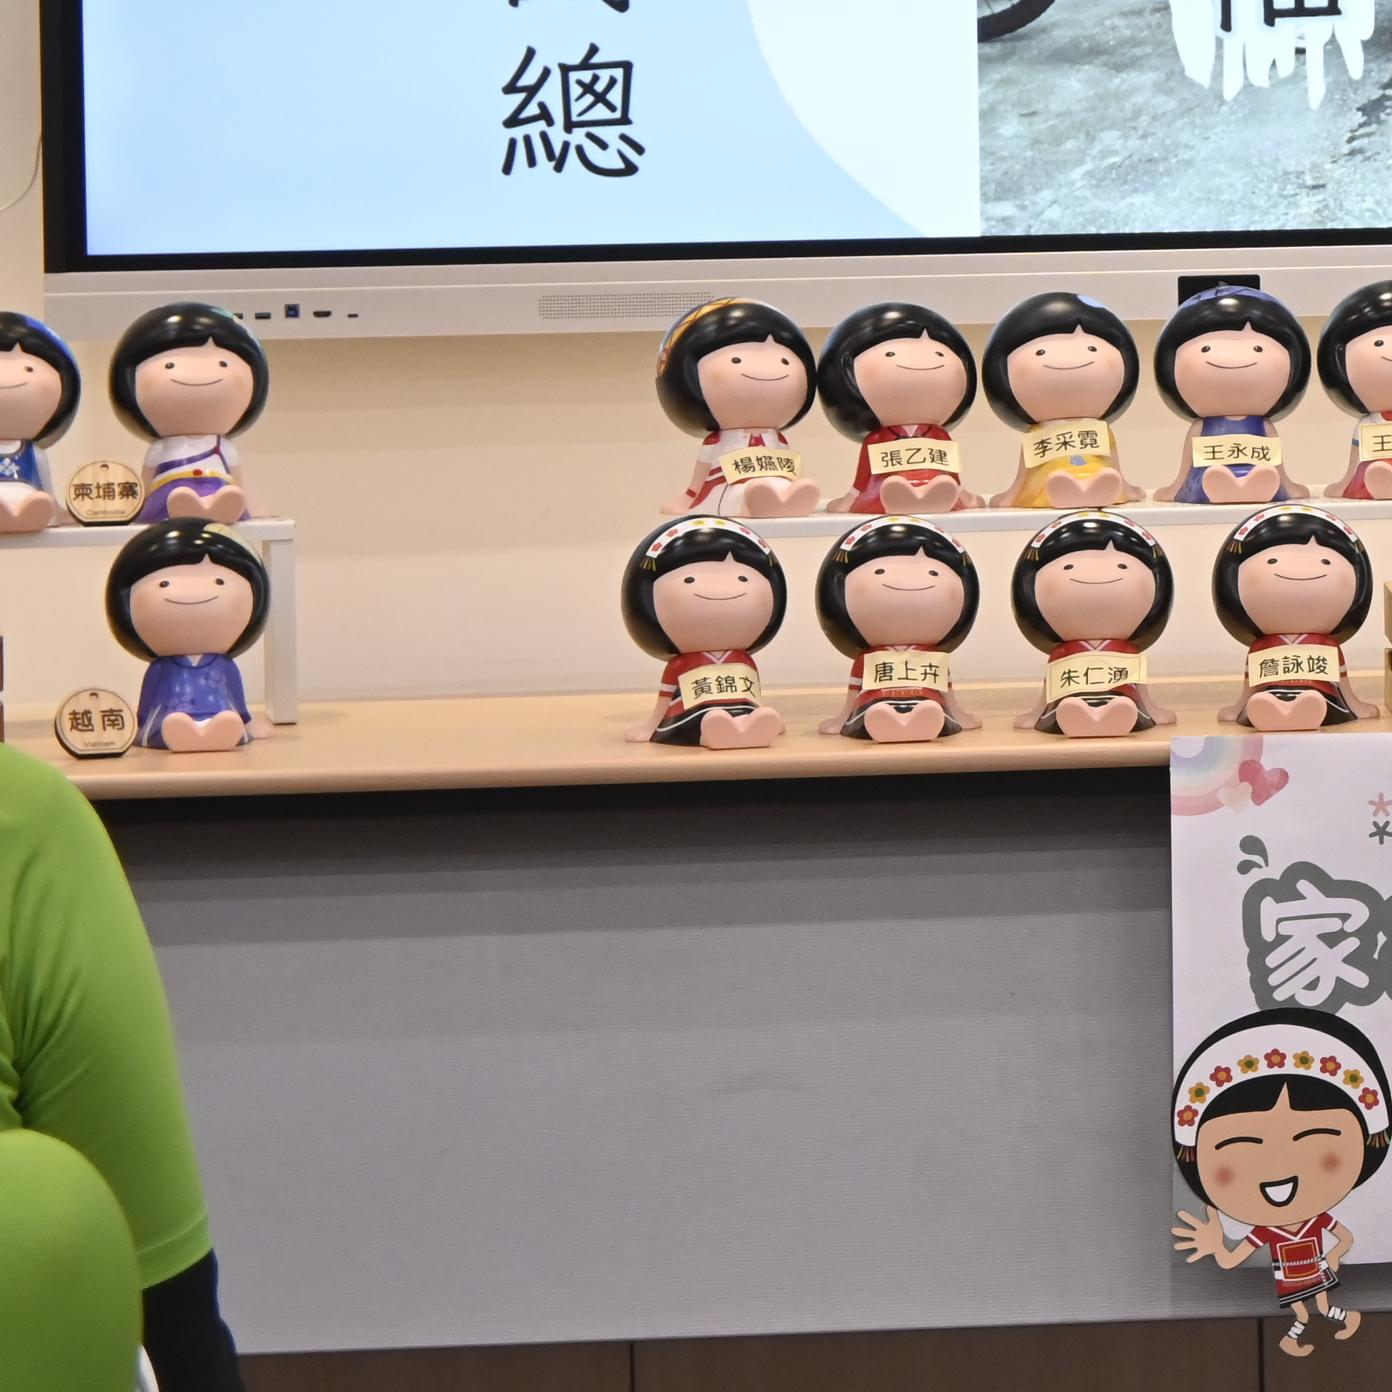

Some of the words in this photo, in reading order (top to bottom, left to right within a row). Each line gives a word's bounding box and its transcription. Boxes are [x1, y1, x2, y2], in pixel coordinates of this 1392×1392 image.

[1033, 430, 1101, 458] 李采霓
[1203, 442, 1272, 462] 王永成
[880, 447, 950, 468] 張乙建
[72, 481, 139, 501] 柬埔寨
[873, 660, 941, 685] 唐上卉
[1258, 654, 1329, 679] 詹詠竣
[690, 674, 757, 699] 黃錦文
[68, 708, 126, 733] 越南
